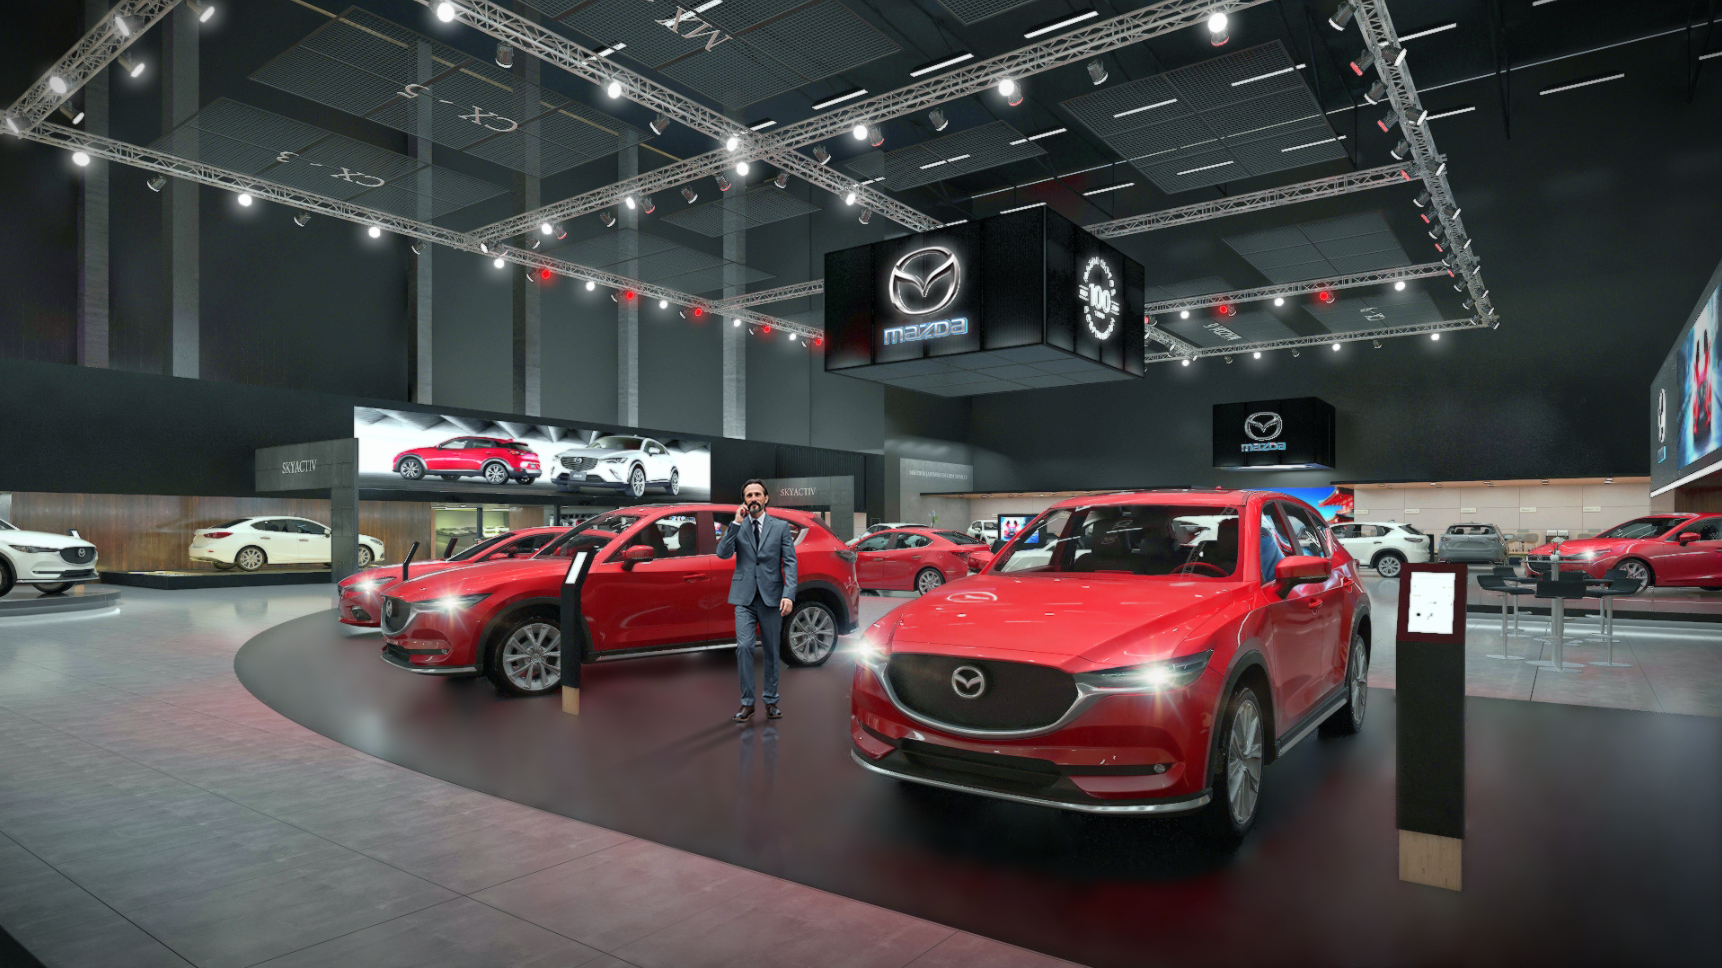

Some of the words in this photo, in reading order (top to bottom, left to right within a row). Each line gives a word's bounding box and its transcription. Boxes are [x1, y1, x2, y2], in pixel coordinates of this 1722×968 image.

[1088, 283, 1111, 313] 100
[883, 317, 969, 345] mazda
[1240, 441, 1287, 452] mazda
[281, 459, 317, 474] SKYACTIV
[780, 486, 816, 496] SKYACTIV
